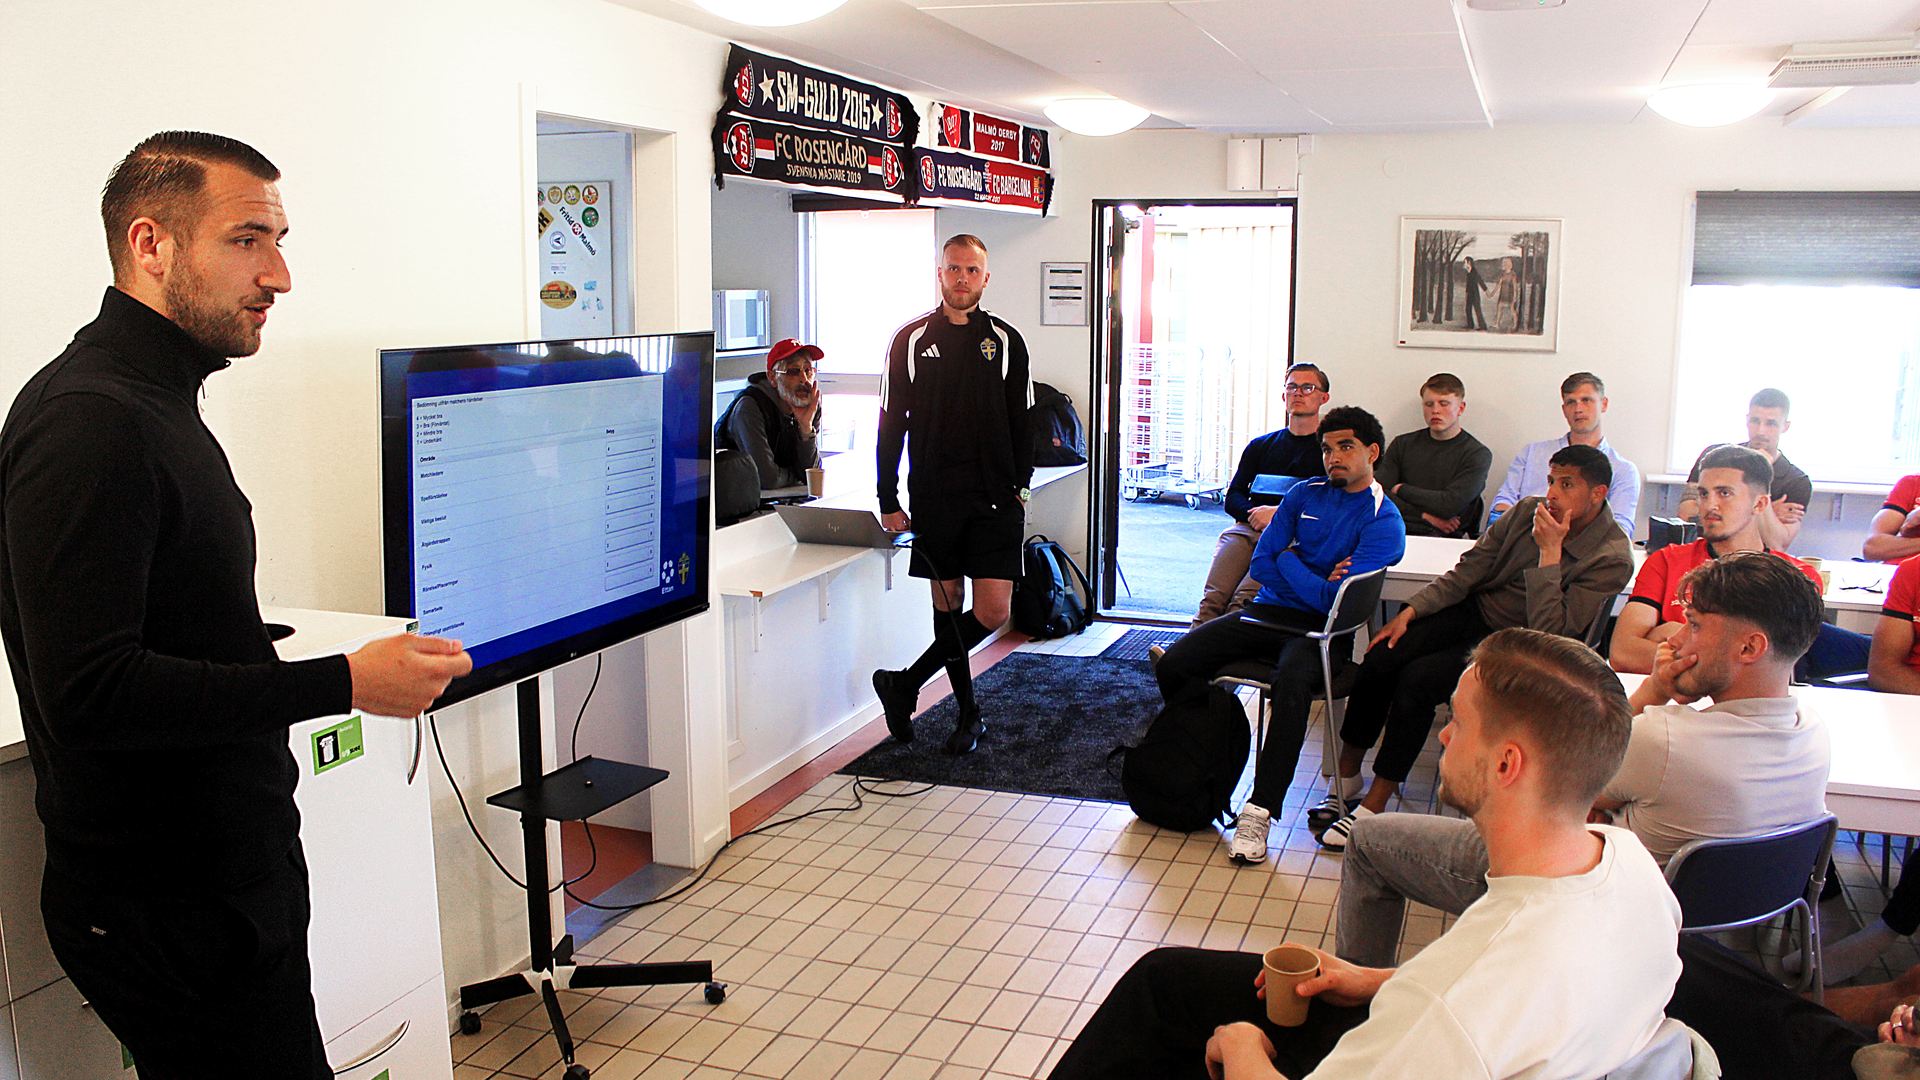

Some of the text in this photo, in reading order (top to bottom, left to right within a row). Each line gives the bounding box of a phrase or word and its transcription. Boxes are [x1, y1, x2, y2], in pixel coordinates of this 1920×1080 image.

[776, 70, 838, 123] SM-GULD
[841, 86, 871, 131] 2015
[975, 122, 1017, 141] MALMÖ DERBY
[990, 139, 1005, 152] 2017
[739, 128, 748, 166] FCR
[774, 132, 793, 160] FC
[795, 135, 868, 169] ROSENGÅRD
[786, 163, 862, 184] SVENSKA MÄSTARE 2019
[937, 164, 947, 187] FC
[947, 164, 983, 192] ROSENGÅRD
[992, 174, 1001, 195] FC
[1000, 175, 1032, 198] BARCELONA
[559, 206, 596, 256] Fritid Malmö
